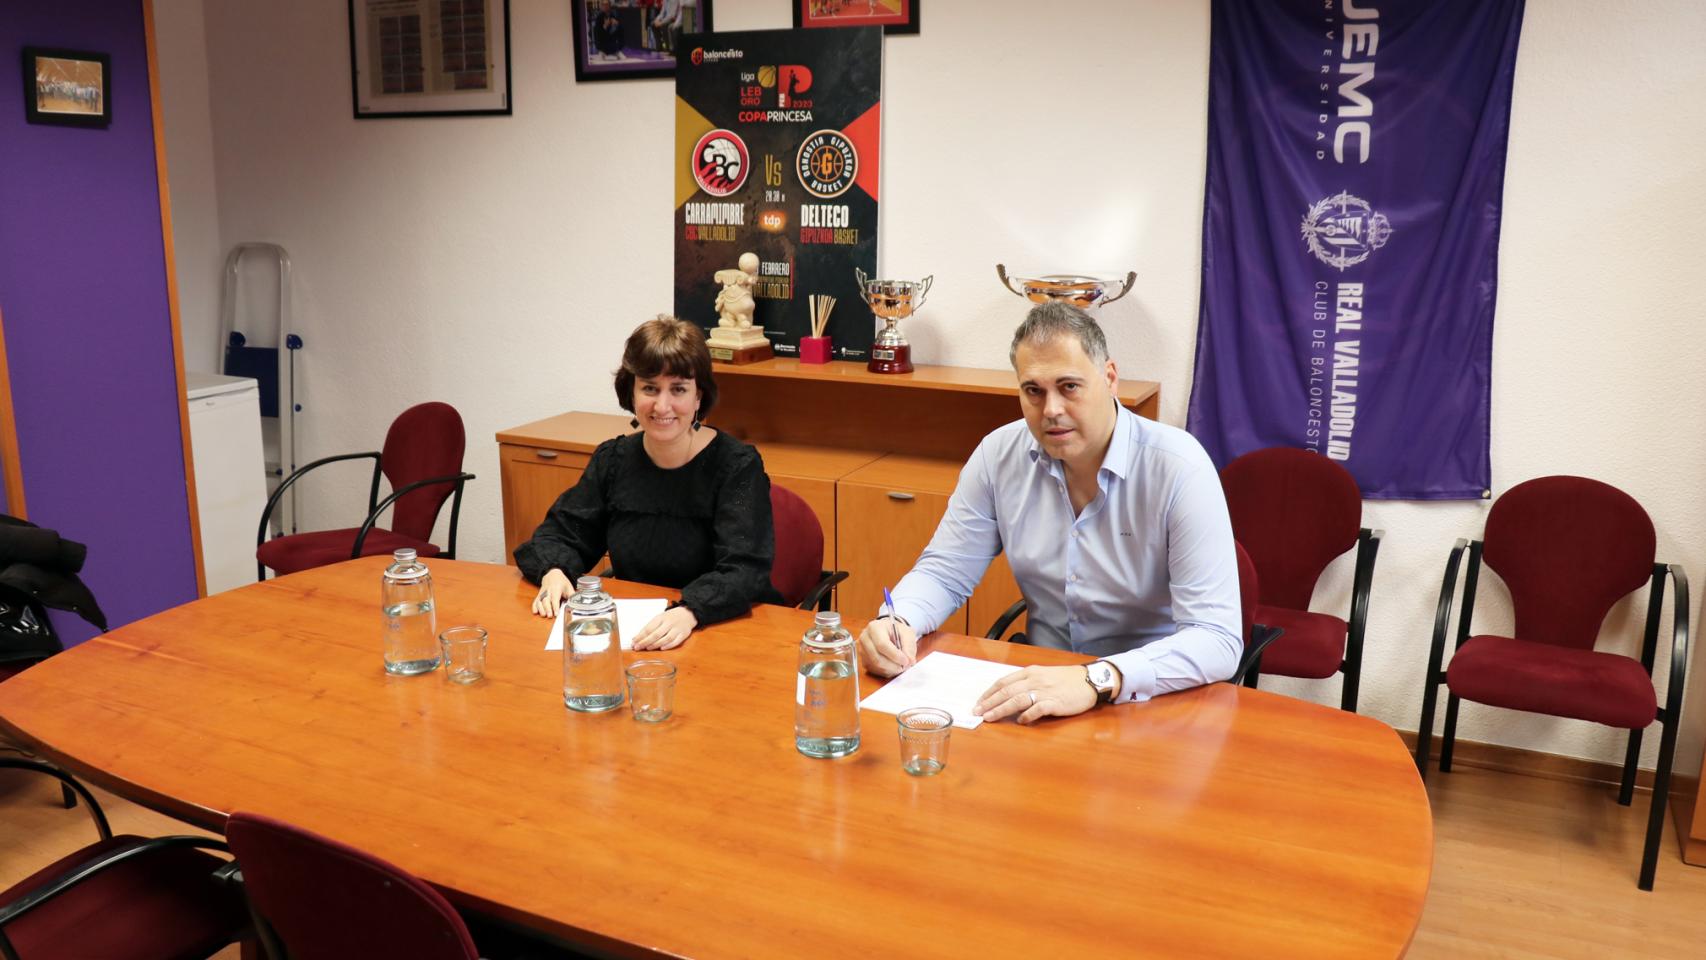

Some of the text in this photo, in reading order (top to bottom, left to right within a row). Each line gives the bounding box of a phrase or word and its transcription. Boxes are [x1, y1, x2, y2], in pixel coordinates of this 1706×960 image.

[741, 72, 755, 82] Liga
[740, 86, 762, 97] LEB
[741, 97, 760, 106] ORO
[811, 180, 843, 193] BASKET
[685, 202, 744, 225] CARRAMIMBRE
[764, 214, 781, 228] tdp
[801, 204, 849, 228] DELTECO
[761, 261, 790, 276] FEBRERO
[1313, 281, 1328, 321] CLUB
[1312, 329, 1326, 349] DE
[1327, 283, 1363, 461] REAL VALLADOLID
